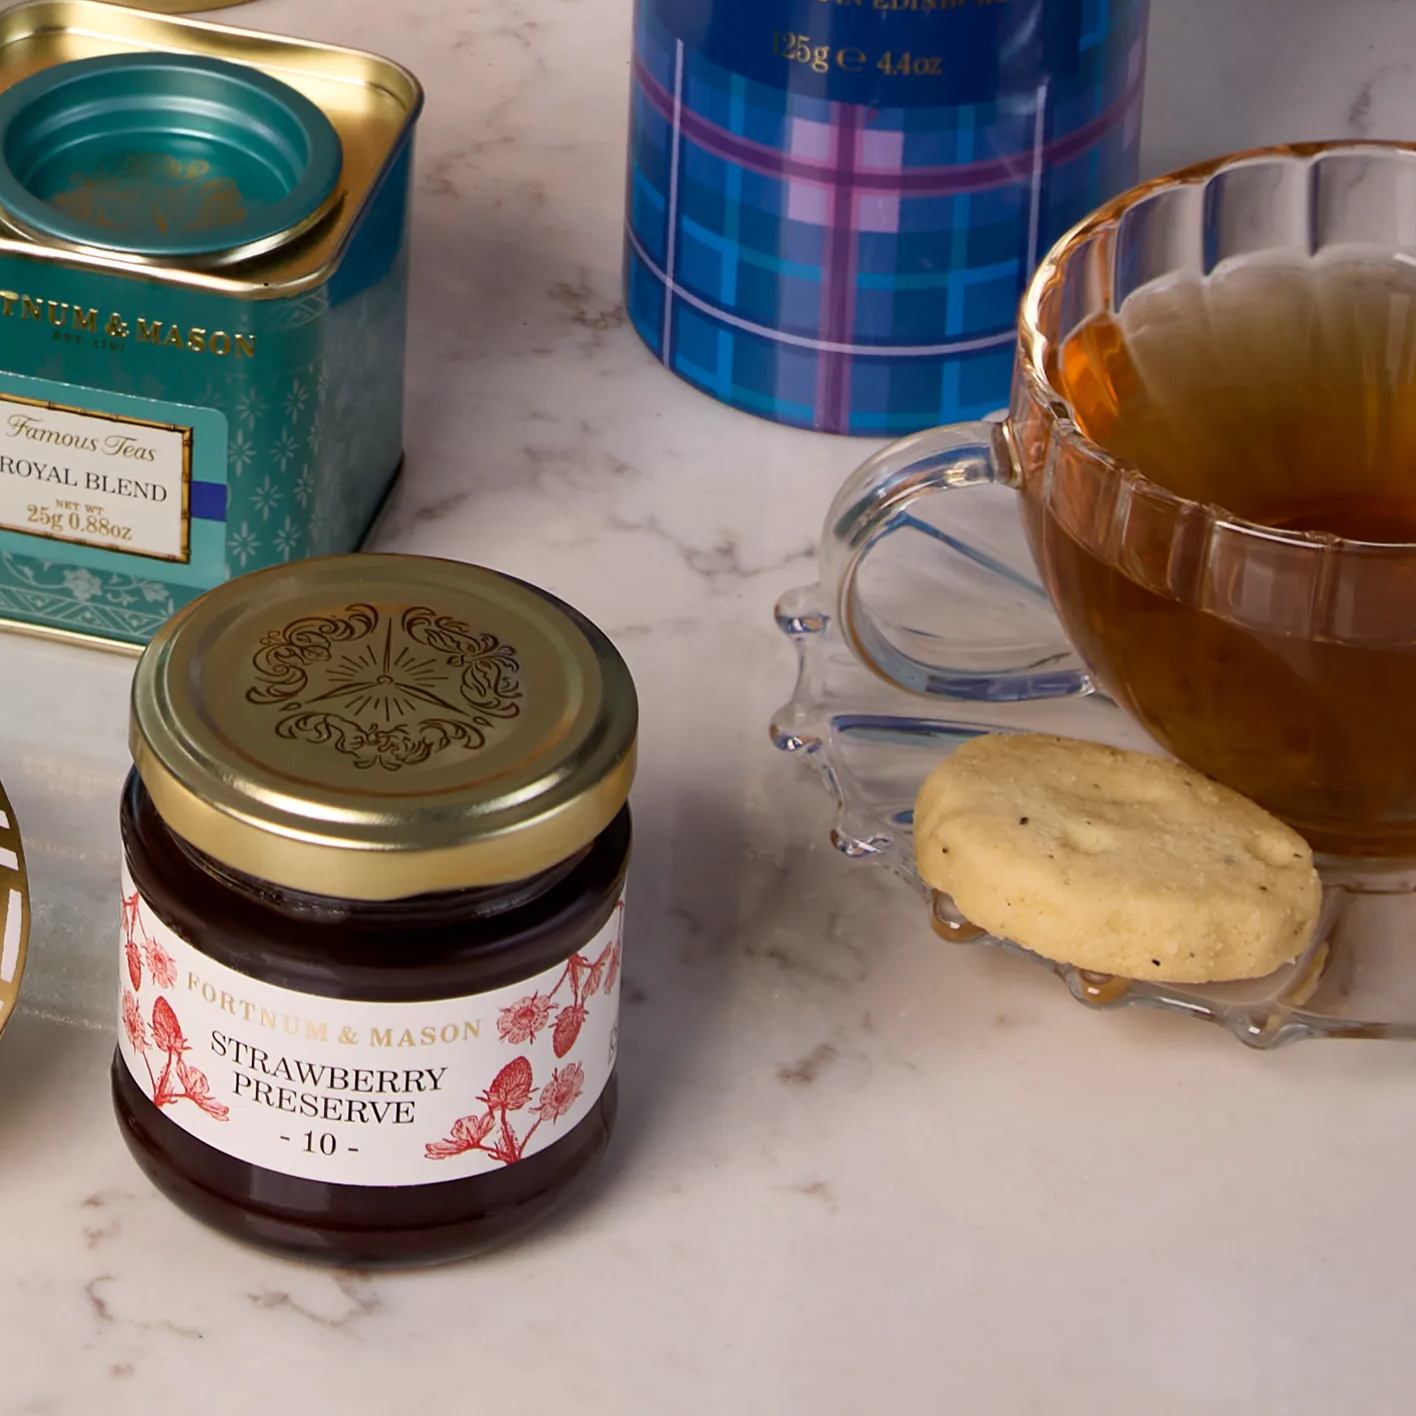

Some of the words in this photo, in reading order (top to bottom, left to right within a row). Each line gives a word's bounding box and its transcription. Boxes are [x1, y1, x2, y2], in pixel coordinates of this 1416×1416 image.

[772, 30, 829, 73] 125g
[877, 51, 943, 76] 4.4oz
[105, 312, 129, 338] &
[136, 318, 256, 358] MASON
[6, 414, 99, 452] Famous
[101, 435, 157, 462] Teas
[56, 499, 80, 511] NET
[85, 505, 105, 515] WT
[85, 471, 167, 502] BLEND
[27, 505, 64, 531] 25g
[69, 513, 132, 541] 0.88oz
[187, 971, 328, 1042] FORTNUM
[338, 1025, 359, 1046] &
[369, 1019, 481, 1047] MASON
[211, 1030, 448, 1094] STRAWBERRY
[232, 1071, 416, 1124] PRESERVE
